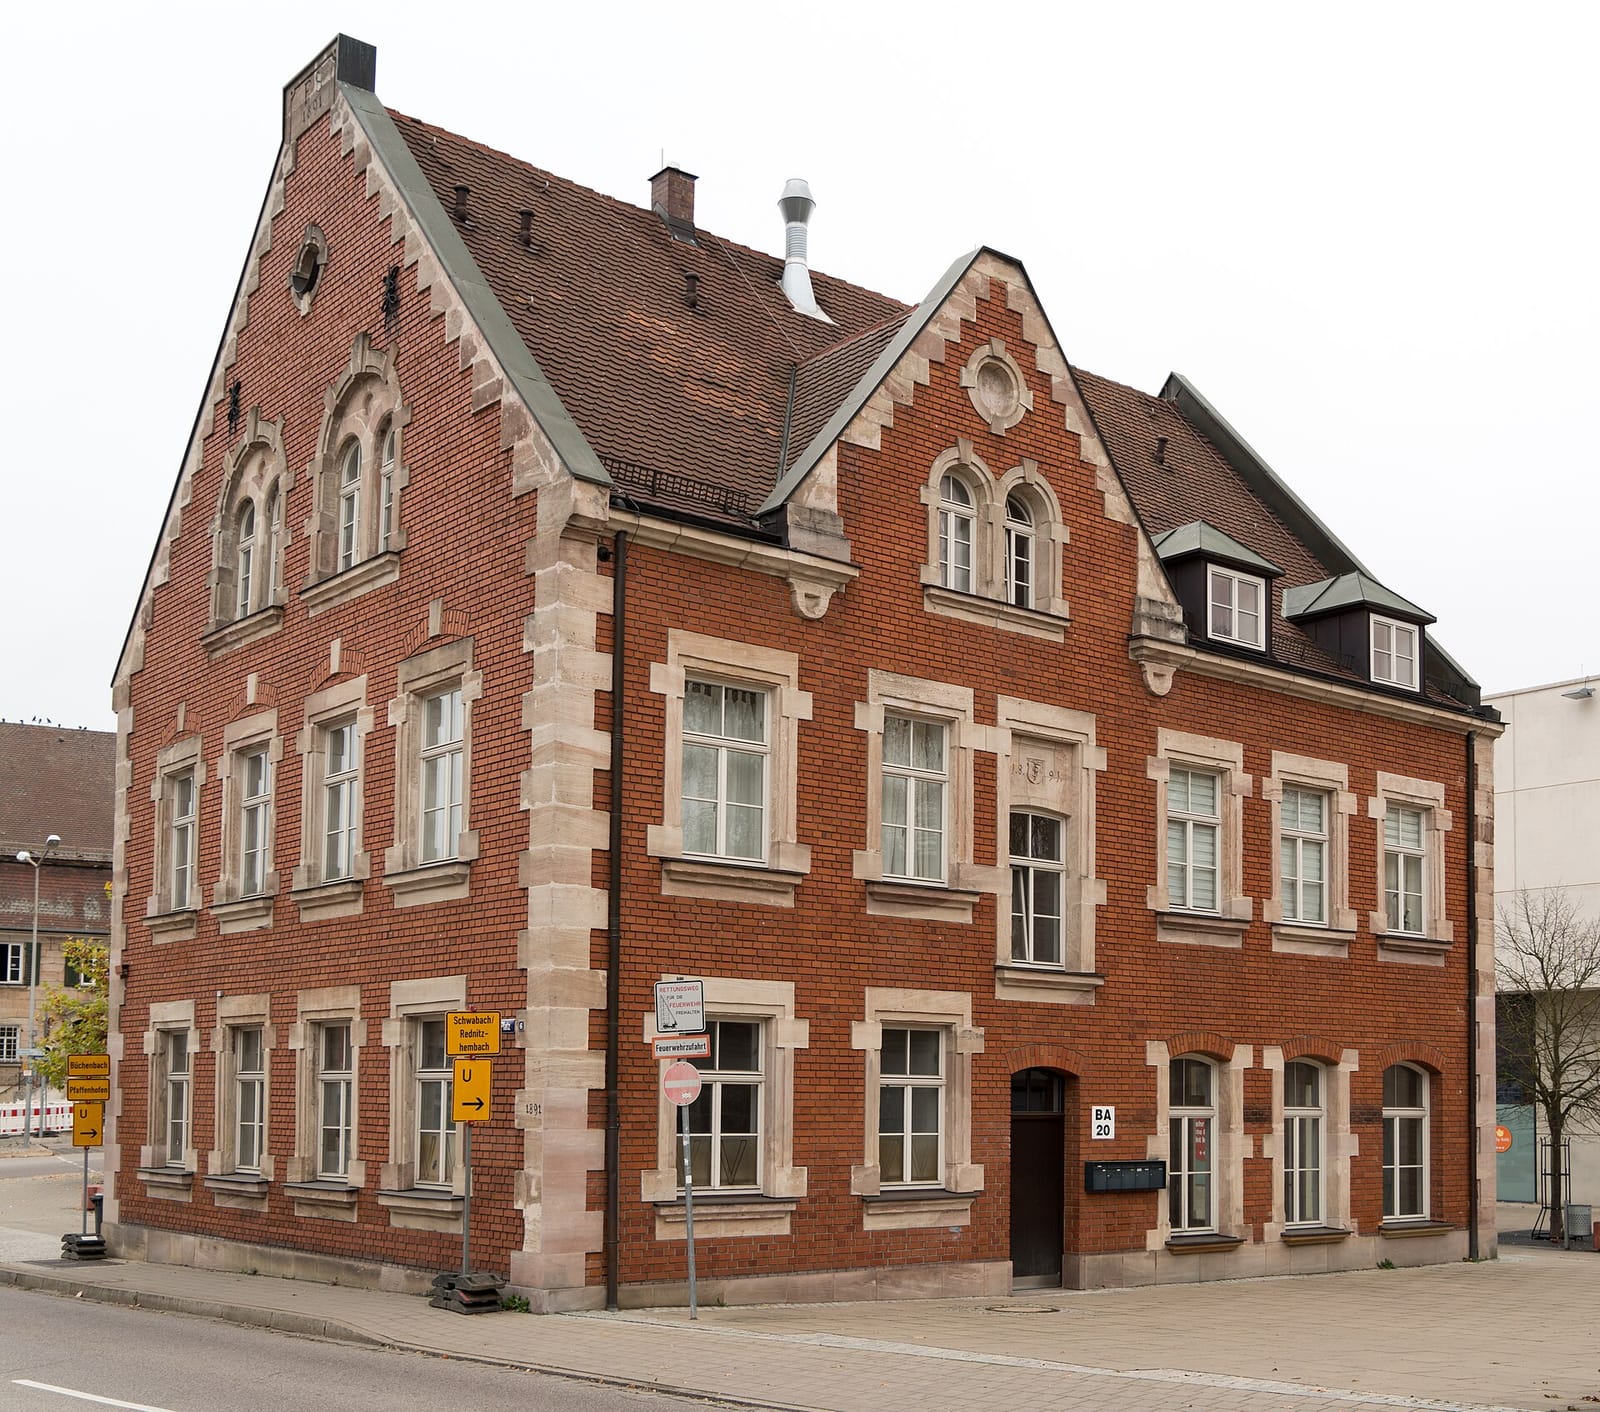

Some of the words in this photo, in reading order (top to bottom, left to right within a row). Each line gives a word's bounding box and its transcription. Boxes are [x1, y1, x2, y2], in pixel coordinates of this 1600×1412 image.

[659, 985, 699, 993] RETTUNGSWEG
[453, 1016, 494, 1025] Schwabach/
[460, 1029, 488, 1038] Rednitz-
[459, 1042, 490, 1052] hembach
[655, 1043, 706, 1052] Feuerwehrzufahrt
[70, 1061, 108, 1070] Büchenbach
[462, 1068, 472, 1082] U
[70, 1086, 108, 1094] Pfaffenhofen
[80, 1109, 88, 1119] U
[525, 1103, 542, 1116] 1891
[1095, 1108, 1112, 1121] BA
[1096, 1124, 1110, 1136] 20
